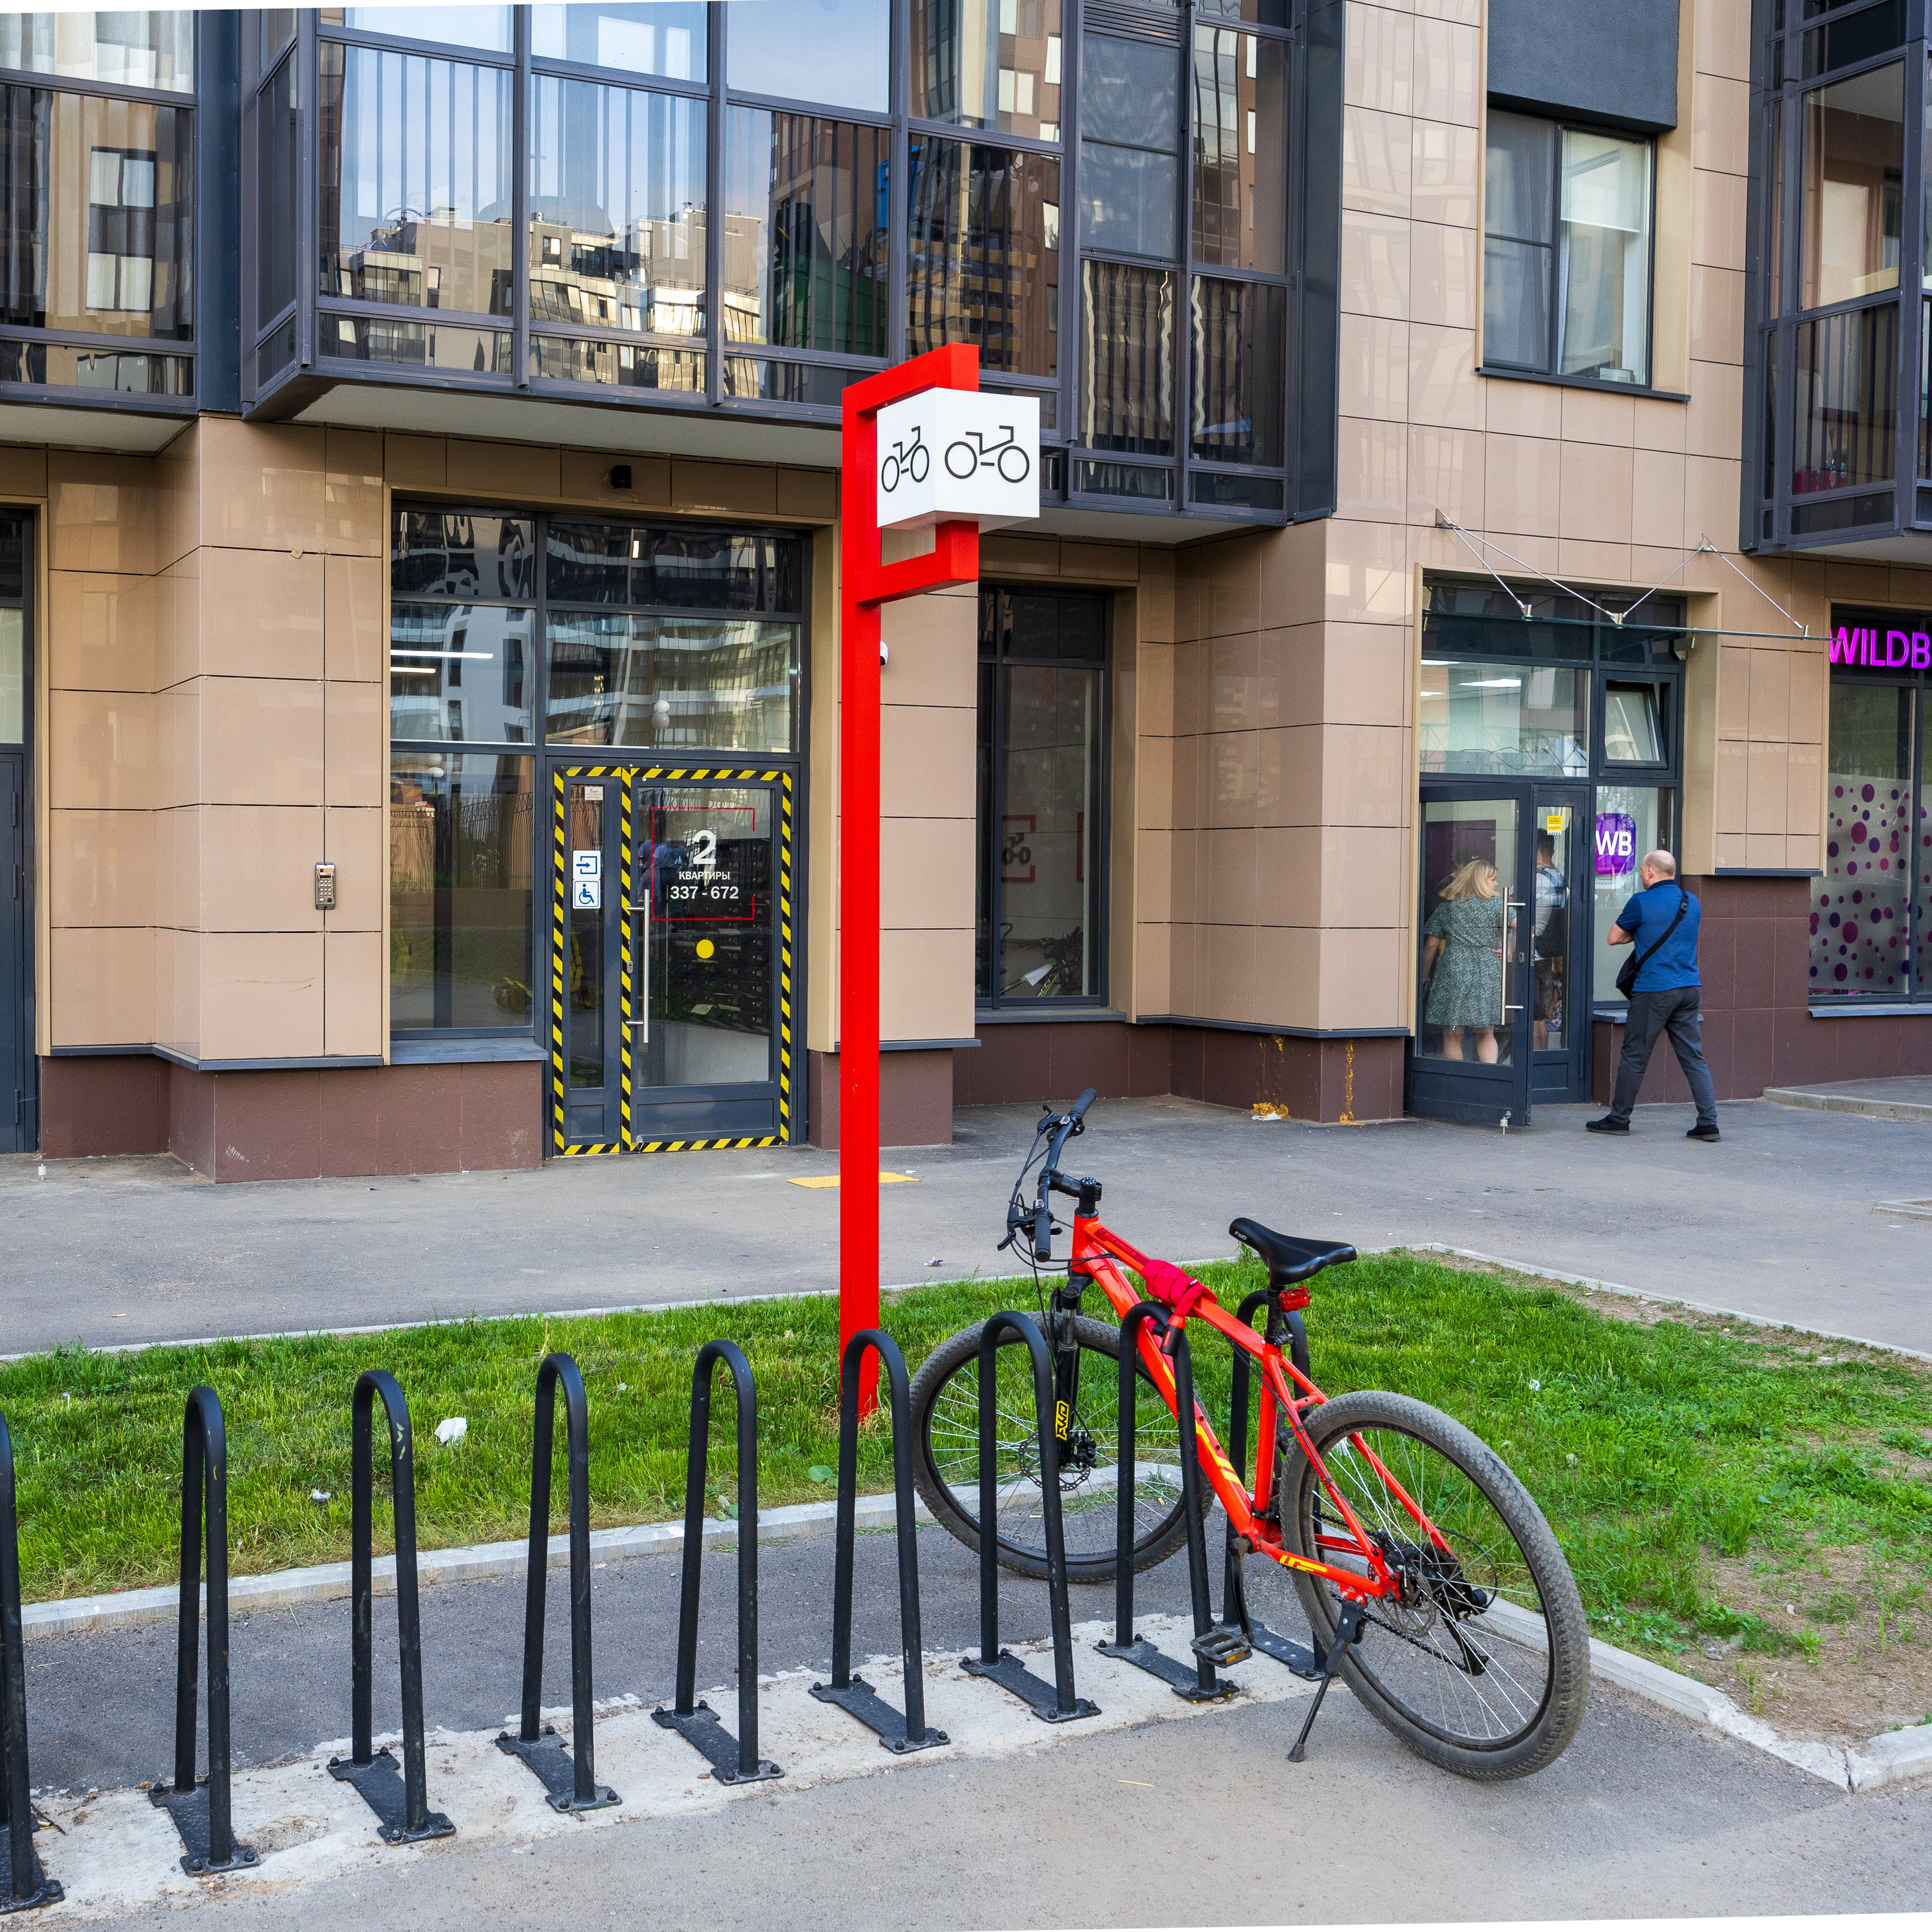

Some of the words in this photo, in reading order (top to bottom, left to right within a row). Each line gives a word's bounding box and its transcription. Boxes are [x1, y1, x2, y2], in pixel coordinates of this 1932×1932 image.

[1830, 627, 1931, 669] WILDB
[693, 829, 716, 864] 2
[1595, 830, 1632, 857] WB
[679, 871, 730, 880] КВАРТИРЫ
[670, 886, 699, 899] 337
[710, 886, 739, 899] 672
[1235, 1231, 1247, 1240] FWD
[1115, 1239, 1137, 1256] KATANA
